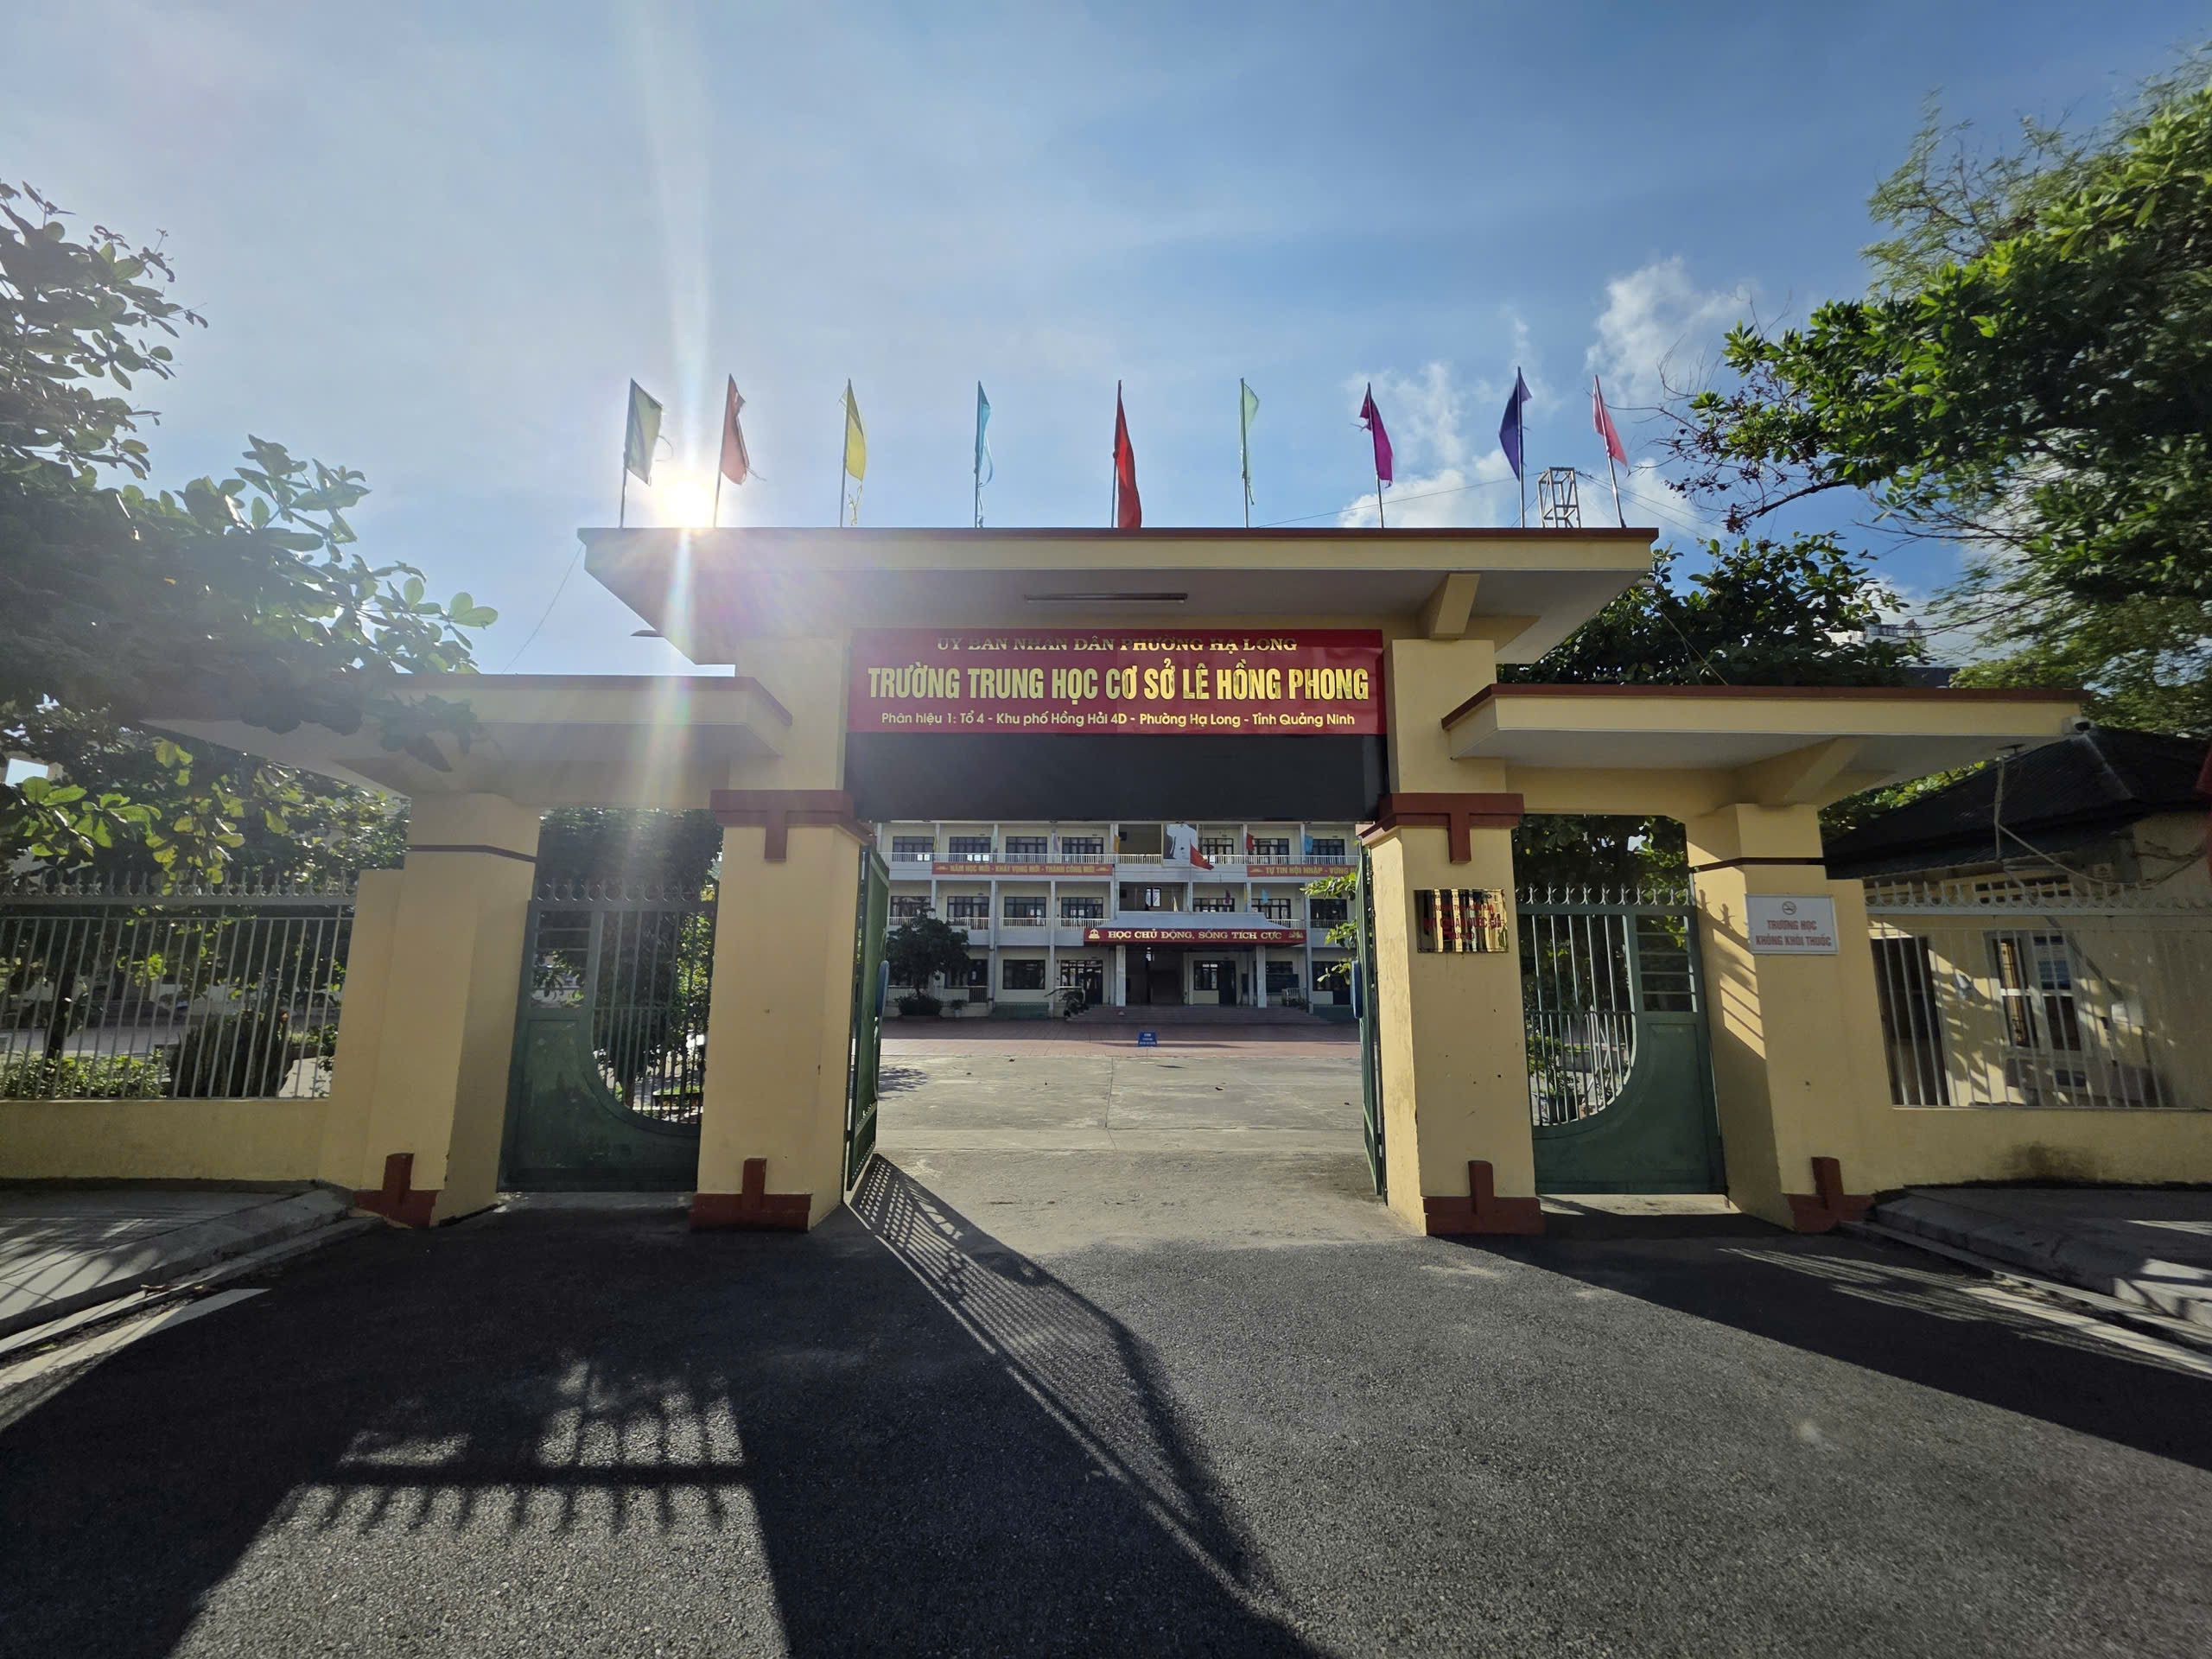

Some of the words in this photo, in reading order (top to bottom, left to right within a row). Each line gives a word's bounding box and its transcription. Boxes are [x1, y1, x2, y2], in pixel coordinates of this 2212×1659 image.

[1073, 635, 1115, 650] DÂN
[1210, 638, 1238, 654] HẠ
[1243, 638, 1298, 651] LONG
[868, 661, 960, 698] TRƯỜNG
[968, 668, 1044, 699] TRUNG
[1052, 668, 1098, 705] HỌC
[1105, 665, 1137, 699] CƠ
[1143, 658, 1175, 699] SỞ
[1182, 663, 1210, 699] LÊ
[1217, 659, 1281, 699] HỒNG
[1288, 668, 1369, 699] PHONG
[881, 712, 912, 723] Phân
[915, 712, 942, 725] hiệu
[960, 710, 975, 724] Tổ
[976, 713, 984, 724] 4
[996, 713, 1020, 724] Khu
[1023, 710, 1049, 727] phố
[1051, 710, 1084, 727] Hồng
[1087, 711, 1108, 724] Hải
[1110, 713, 1127, 724] 4D
[1140, 711, 1186, 728] Phường
[1190, 714, 1207, 727] Hạ
[1210, 714, 1241, 728] Long
[1252, 711, 1276, 725] Tỉnh
[1279, 711, 1325, 728] Quảng
[1326, 713, 1355, 725] Ninh
[1801, 920, 1817, 932] HỌC
[1134, 928, 1158, 938] CHỦ
[1231, 930, 1257, 939] TÍCH
[1261, 931, 1282, 940] CỰC
[1805, 934, 1832, 946] THUỐC
